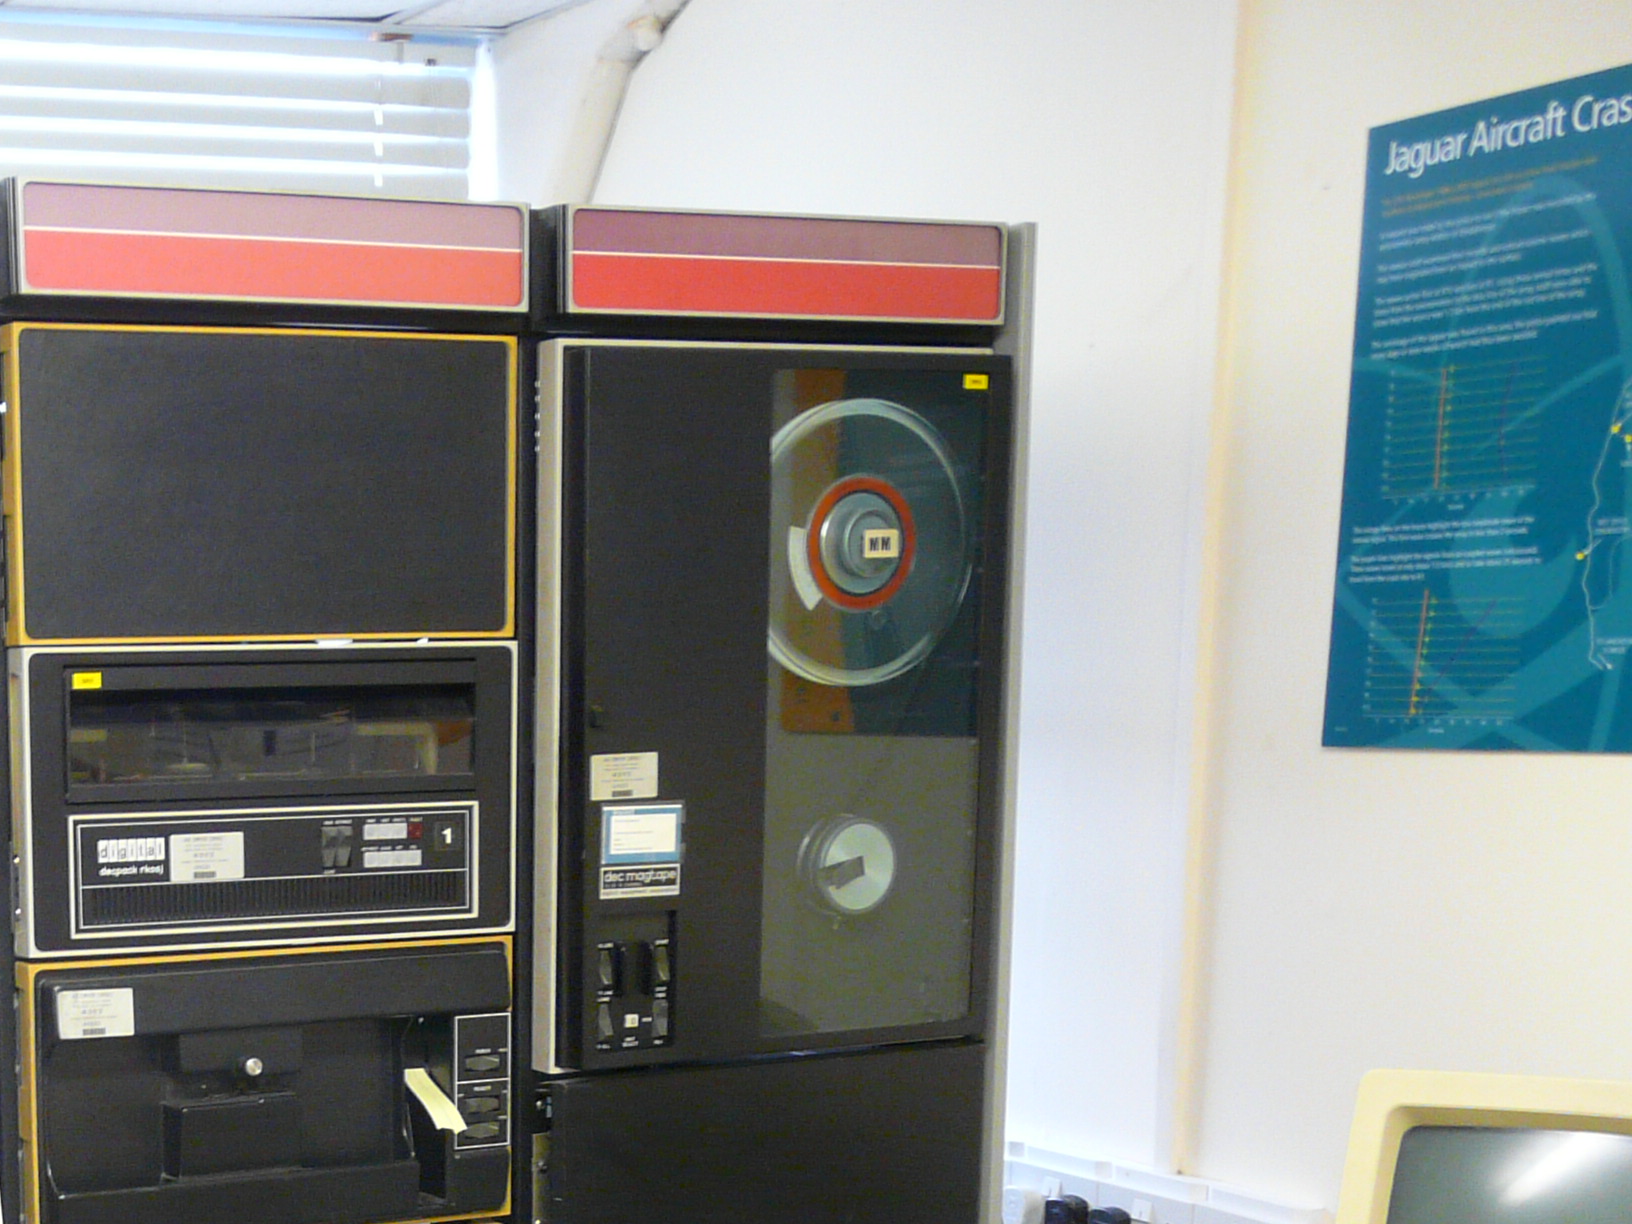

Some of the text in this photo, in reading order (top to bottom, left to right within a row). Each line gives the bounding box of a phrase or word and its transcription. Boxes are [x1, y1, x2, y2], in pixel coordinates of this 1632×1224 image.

[1384, 94, 1632, 178] Jaguar Aircraft Cras
[441, 827, 452, 844] 1
[99, 841, 163, 861] digital
[603, 868, 677, 884] dec magtape
